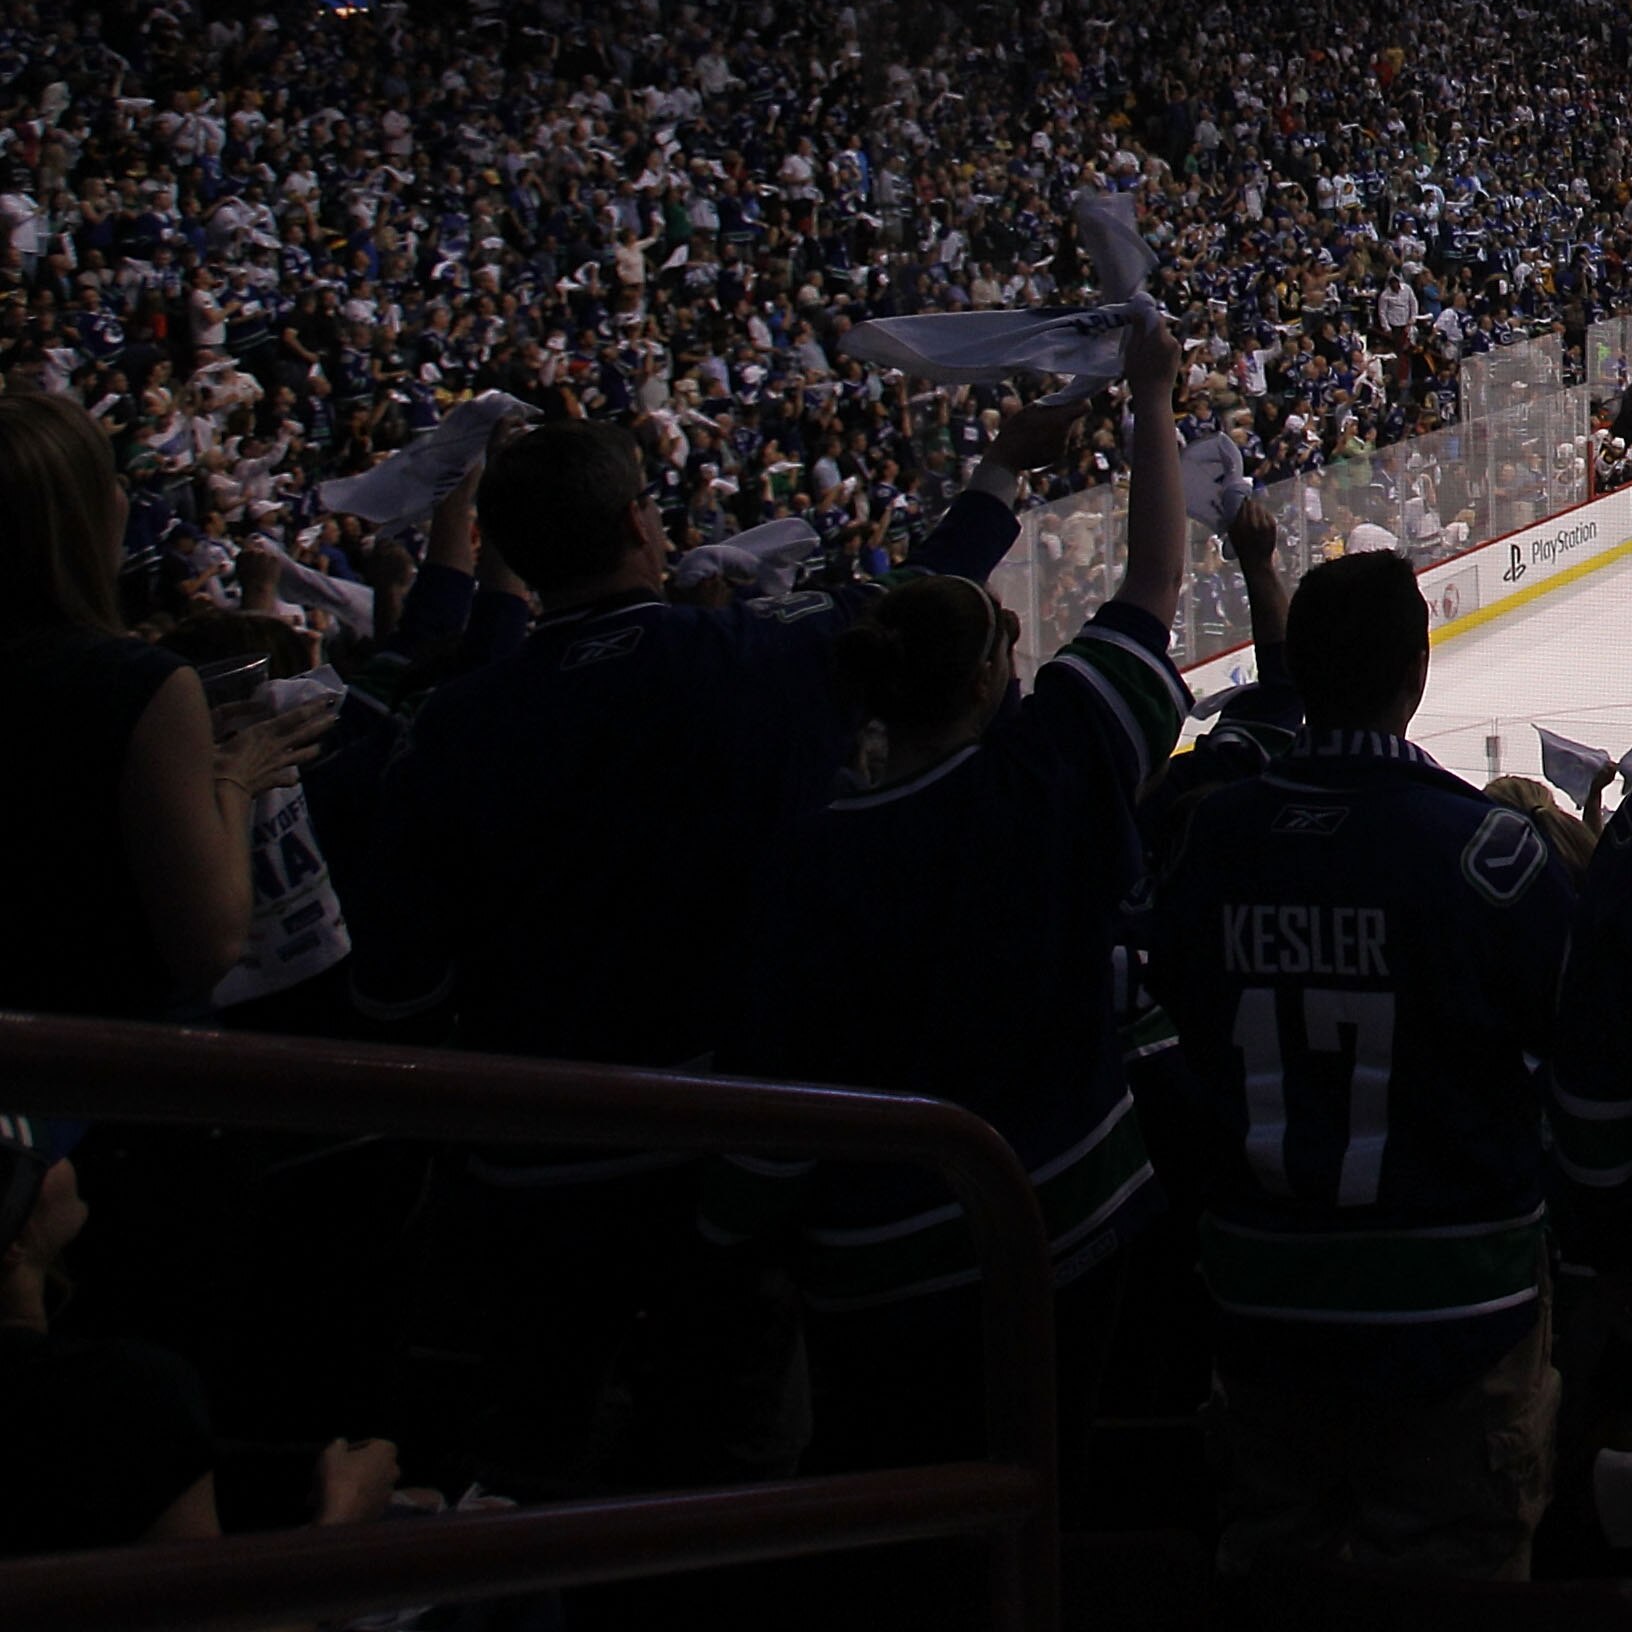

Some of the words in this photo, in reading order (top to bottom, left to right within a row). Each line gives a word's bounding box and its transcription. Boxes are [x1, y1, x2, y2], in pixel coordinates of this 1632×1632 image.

[1531, 520, 1597, 564] PlayStation
[1222, 903, 1391, 977] KESLER
[1232, 987, 1397, 1209] 17
